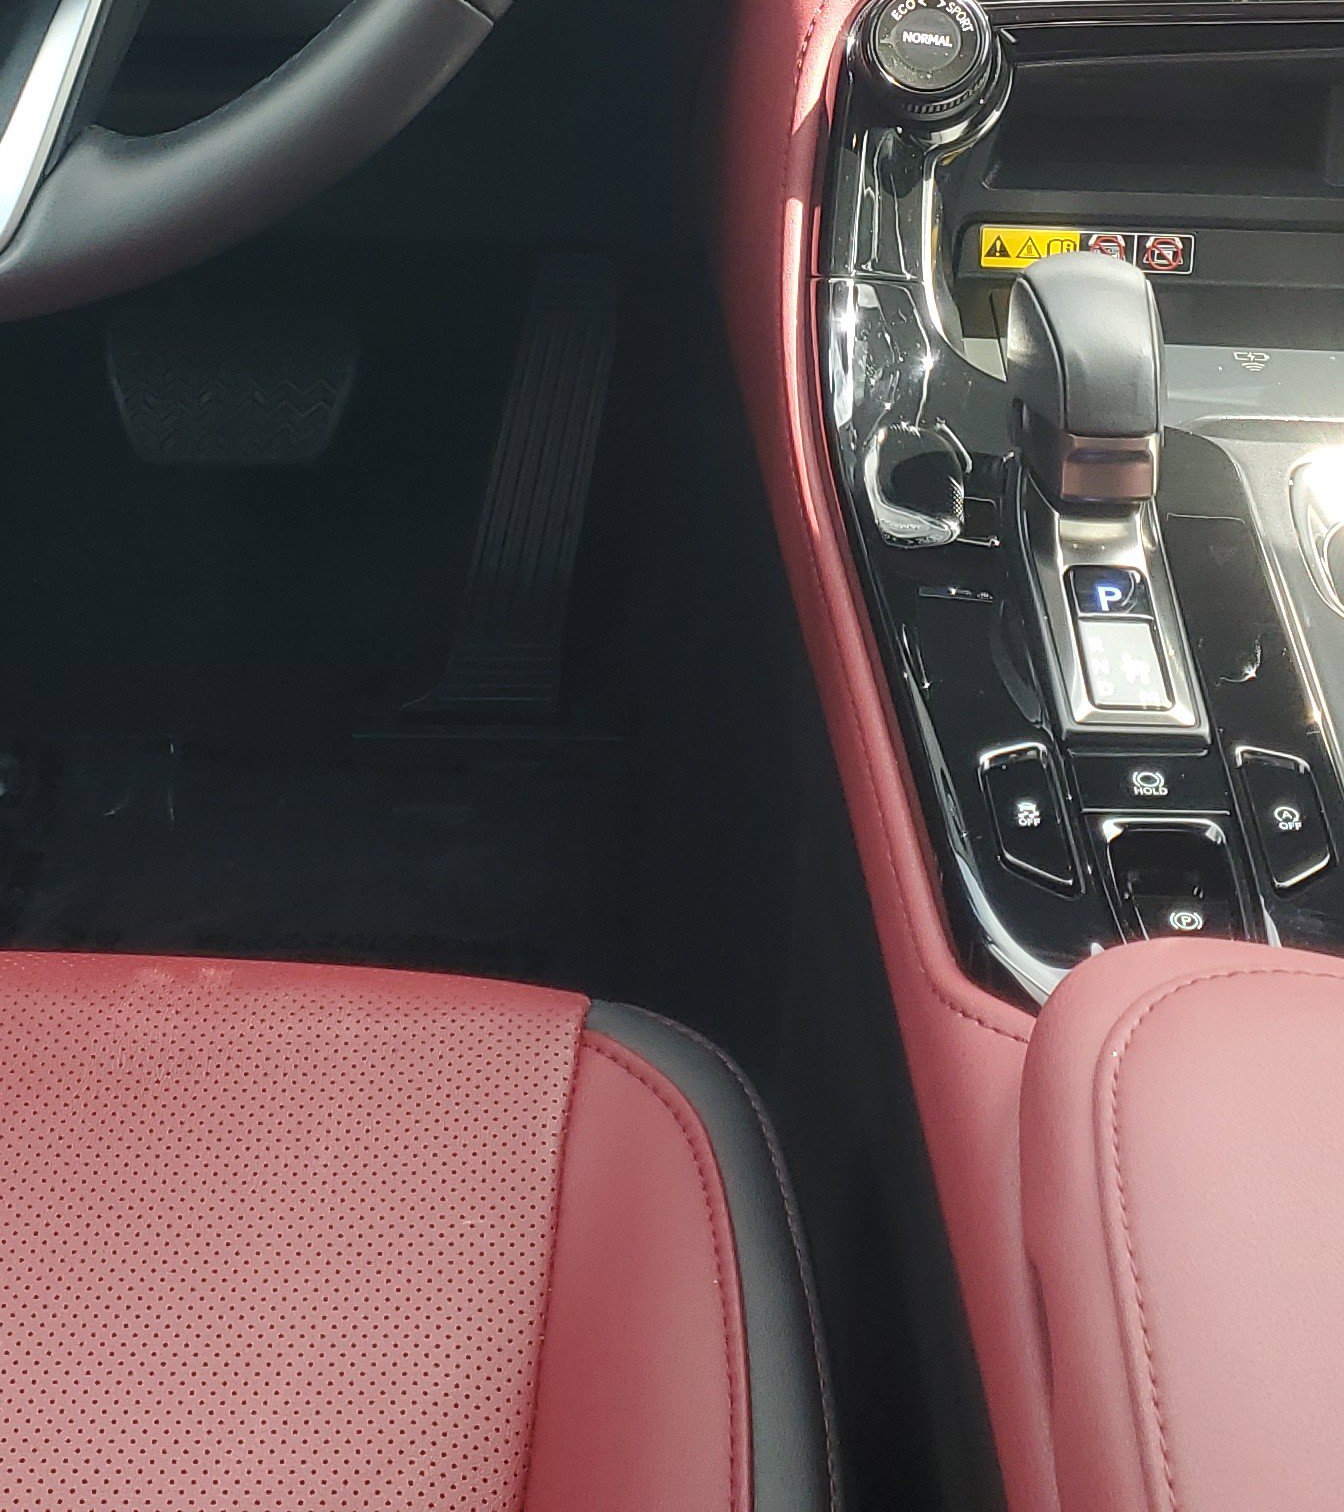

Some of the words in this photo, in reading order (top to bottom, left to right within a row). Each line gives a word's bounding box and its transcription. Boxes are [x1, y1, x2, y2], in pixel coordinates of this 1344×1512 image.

[945, 1, 974, 33] SPORT
[902, 30, 953, 48] NORMAL
[1097, 586, 1122, 612] P
[1133, 787, 1168, 796] HOLD
[1017, 816, 1041, 827] OFF
[1278, 820, 1302, 831] OFF
